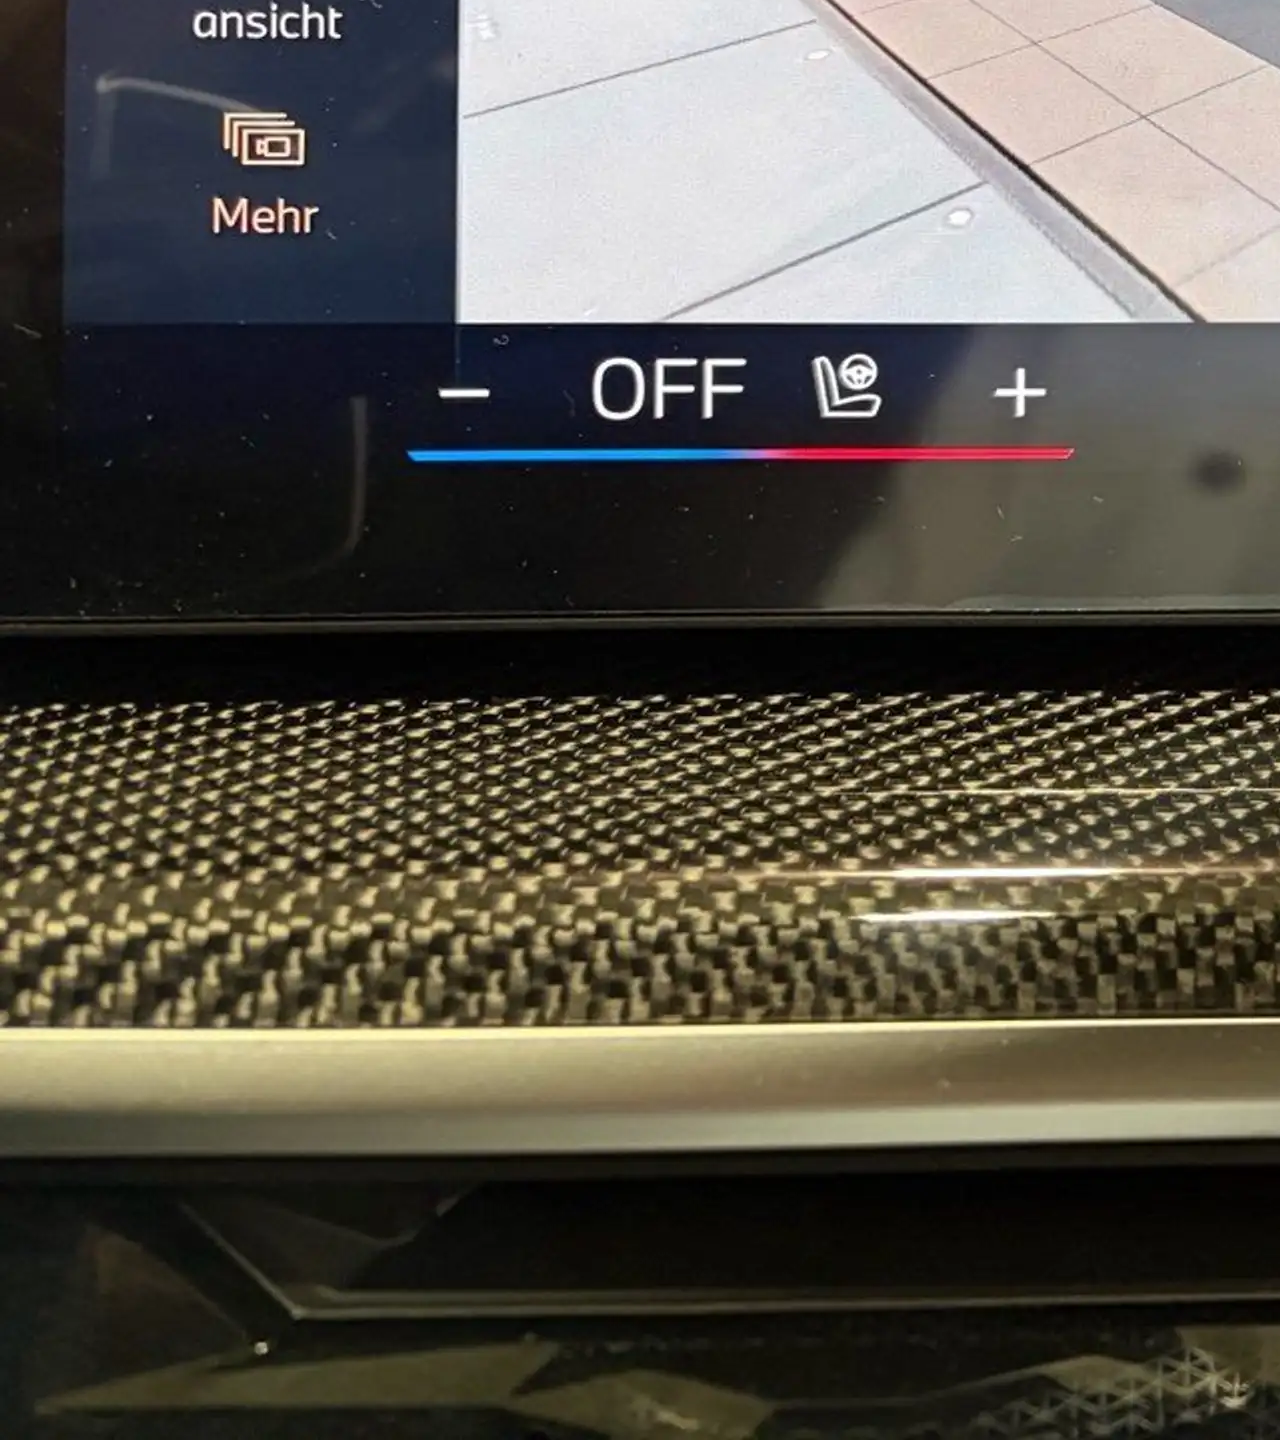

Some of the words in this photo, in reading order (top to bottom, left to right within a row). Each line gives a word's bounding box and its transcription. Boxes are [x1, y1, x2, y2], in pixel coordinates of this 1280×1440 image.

[192, 1, 344, 40] ansicht
[212, 197, 320, 234] Mehr
[592, 357, 747, 421] OFF
